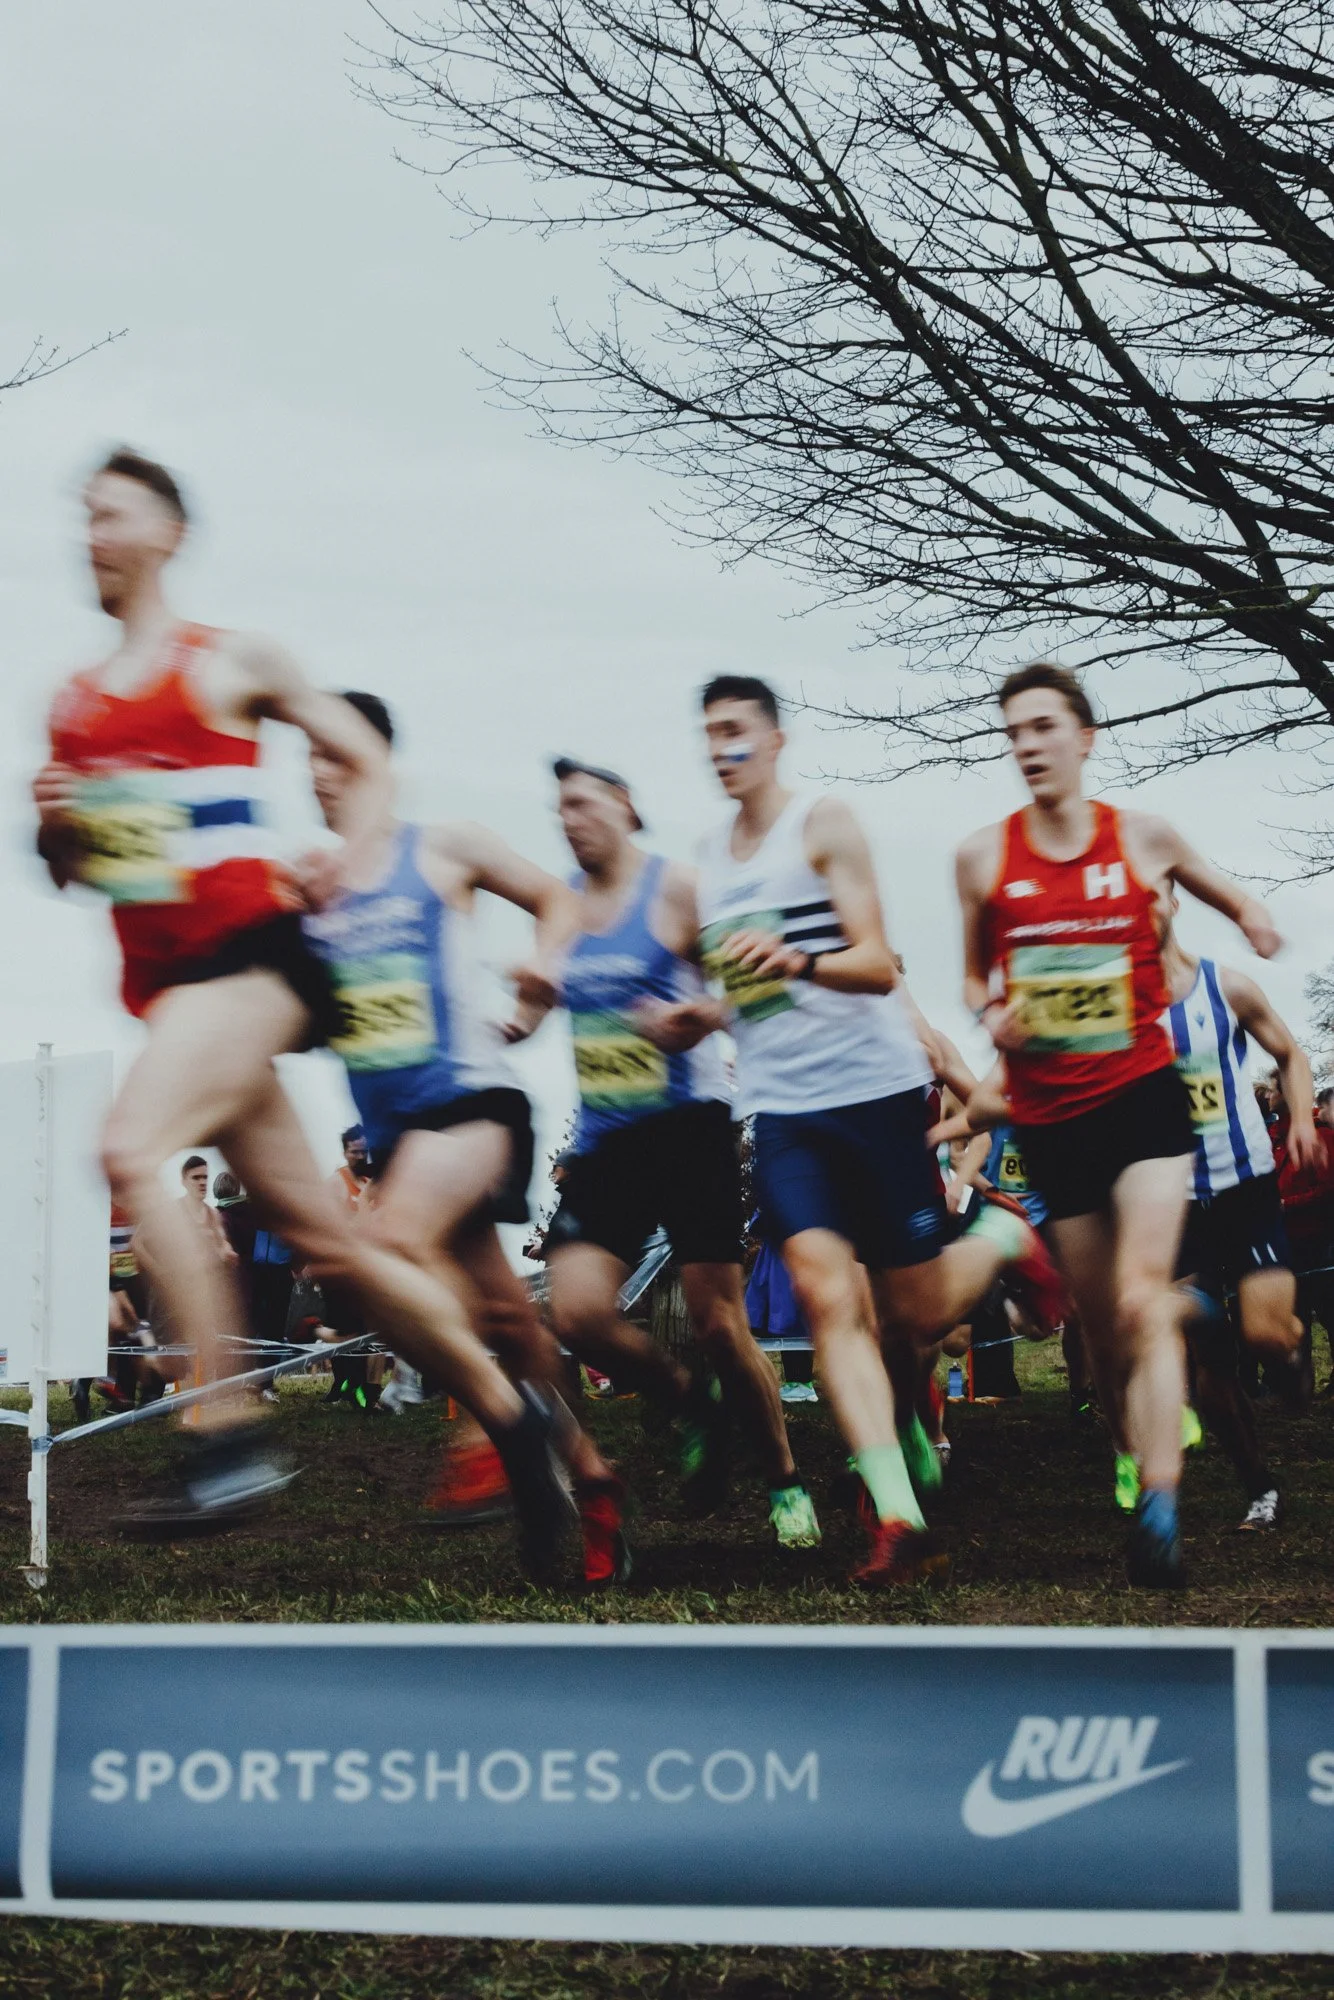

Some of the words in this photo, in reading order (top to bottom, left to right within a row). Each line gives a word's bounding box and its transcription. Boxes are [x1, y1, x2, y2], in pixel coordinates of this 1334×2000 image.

[1083, 860, 1128, 901] H
[1001, 1715, 1160, 1781] RUN
[90, 1749, 819, 1803] SPORTSSHOES.COM
